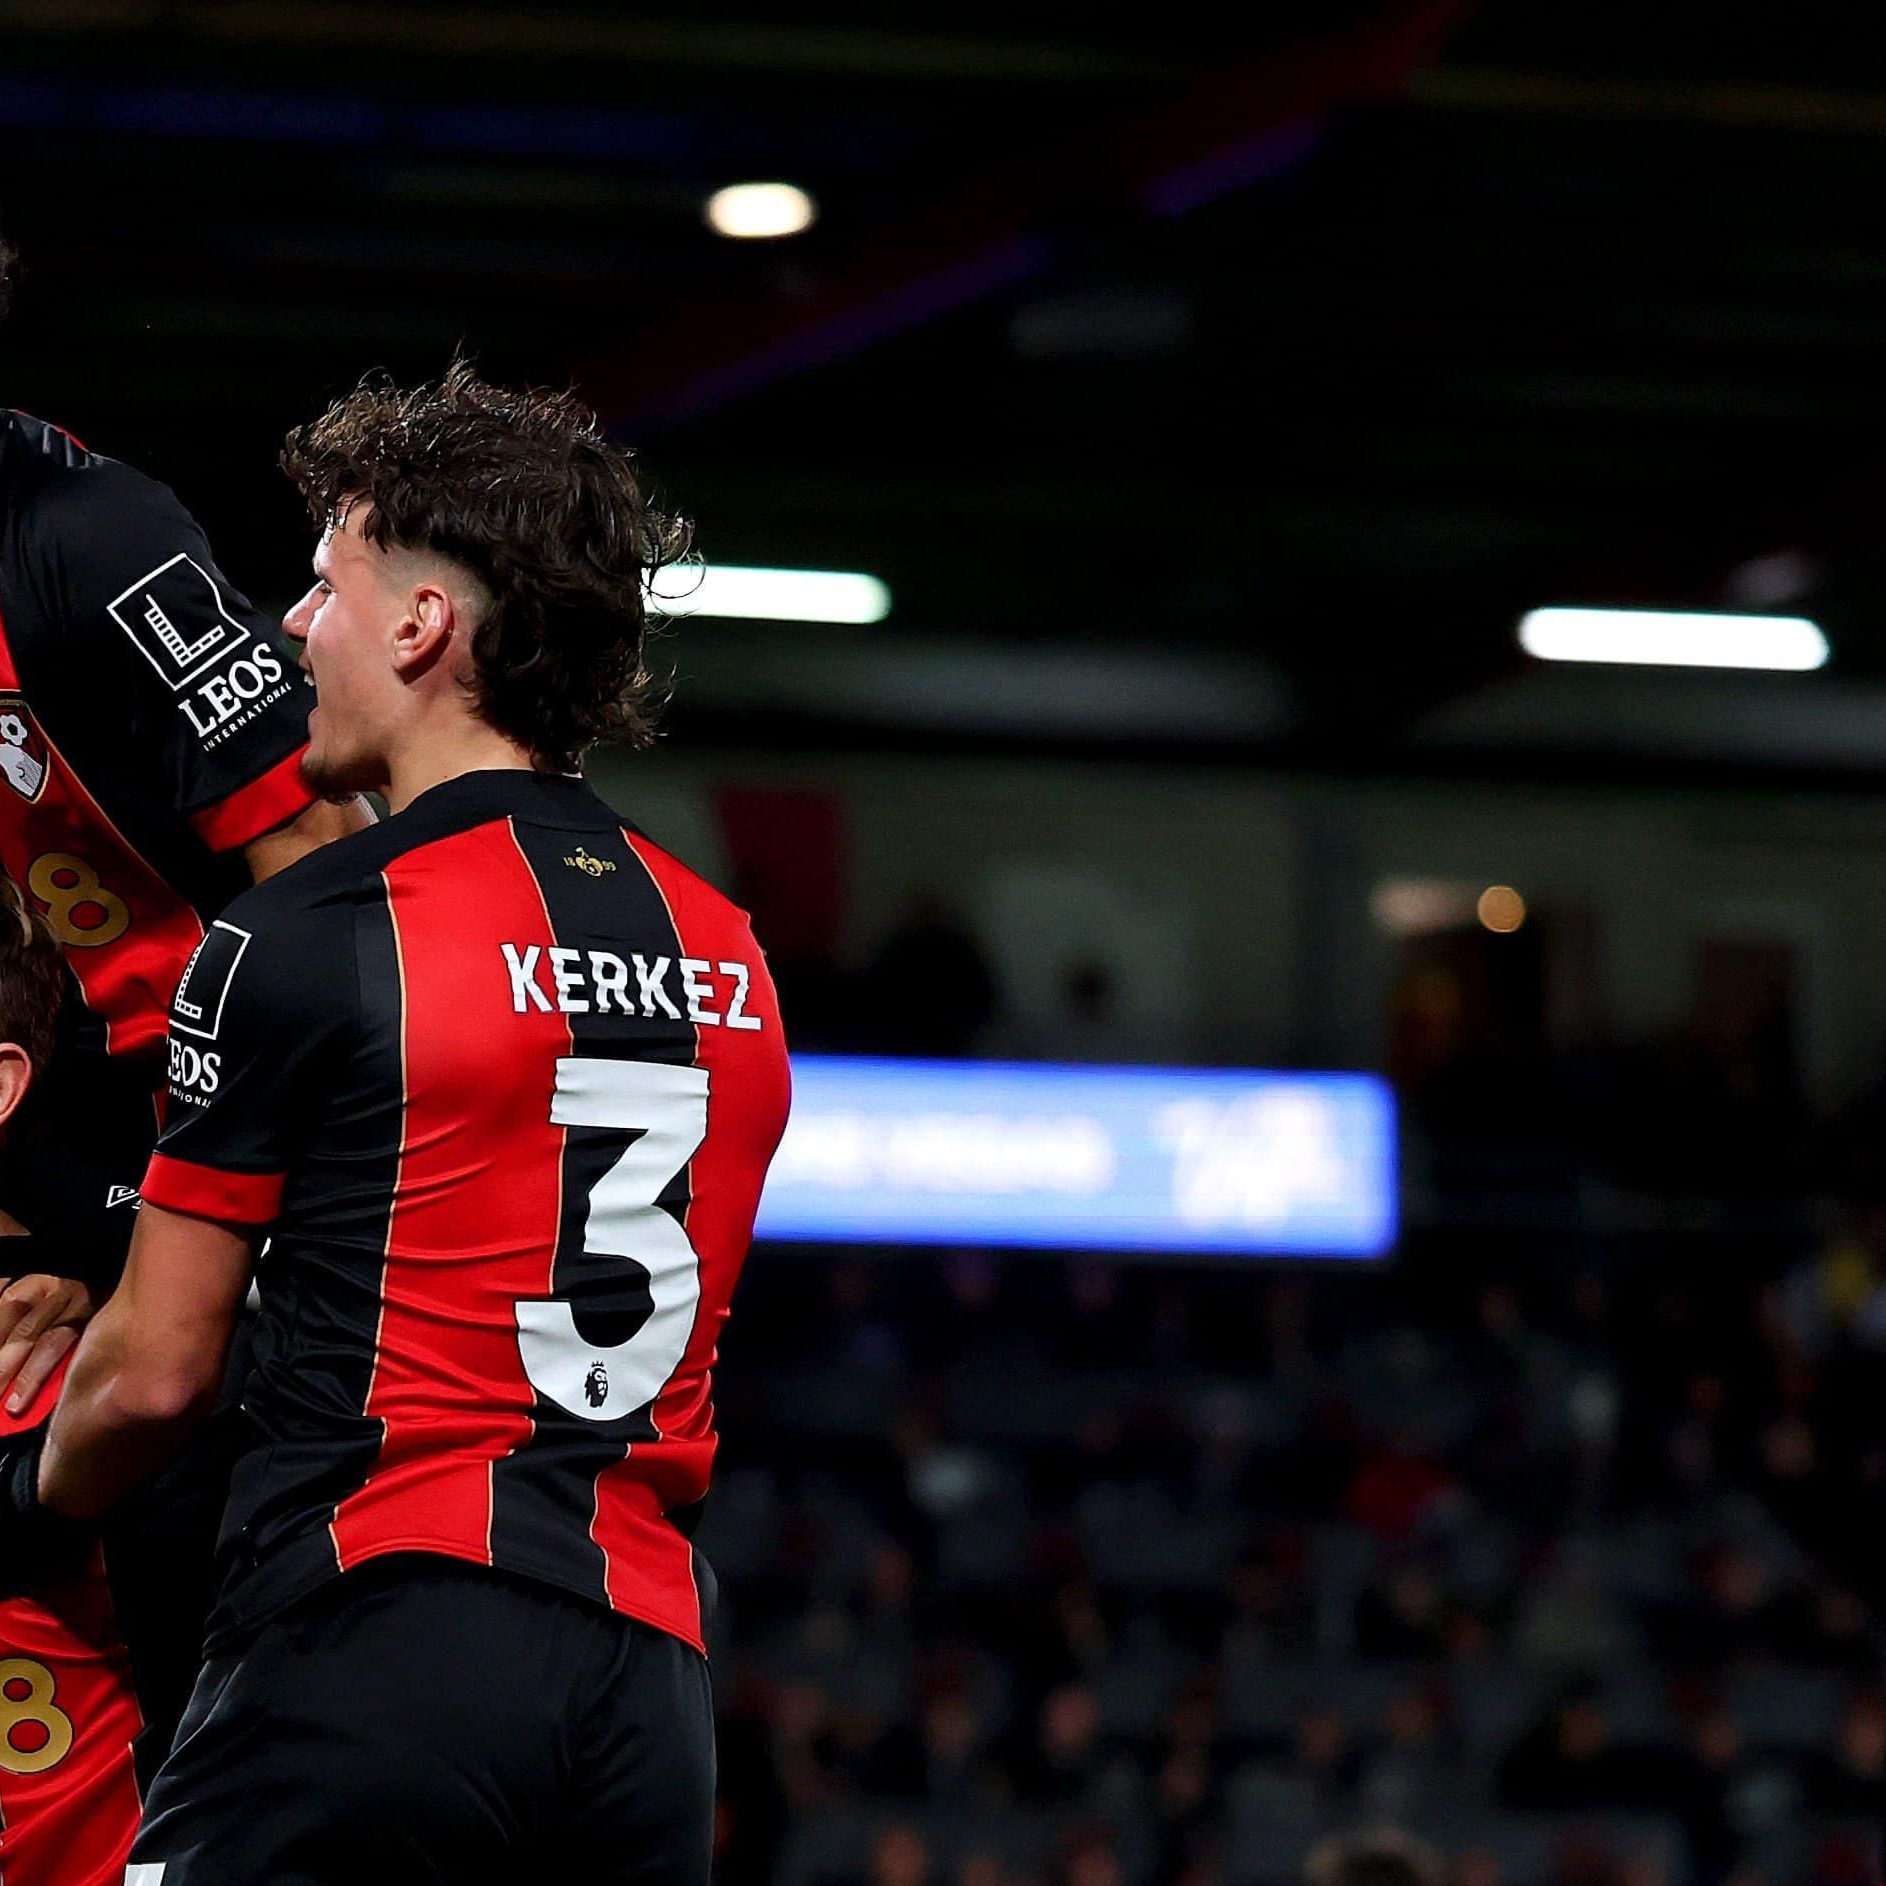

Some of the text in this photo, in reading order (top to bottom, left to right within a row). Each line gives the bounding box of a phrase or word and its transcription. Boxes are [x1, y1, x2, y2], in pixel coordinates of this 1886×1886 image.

[177, 642, 282, 738] LEOS
[202, 682, 292, 752] INTERNATIONAL
[499, 942, 762, 1032] KERKEZ
[166, 1034, 222, 1093] EOS
[514, 1056, 711, 1422] 3
